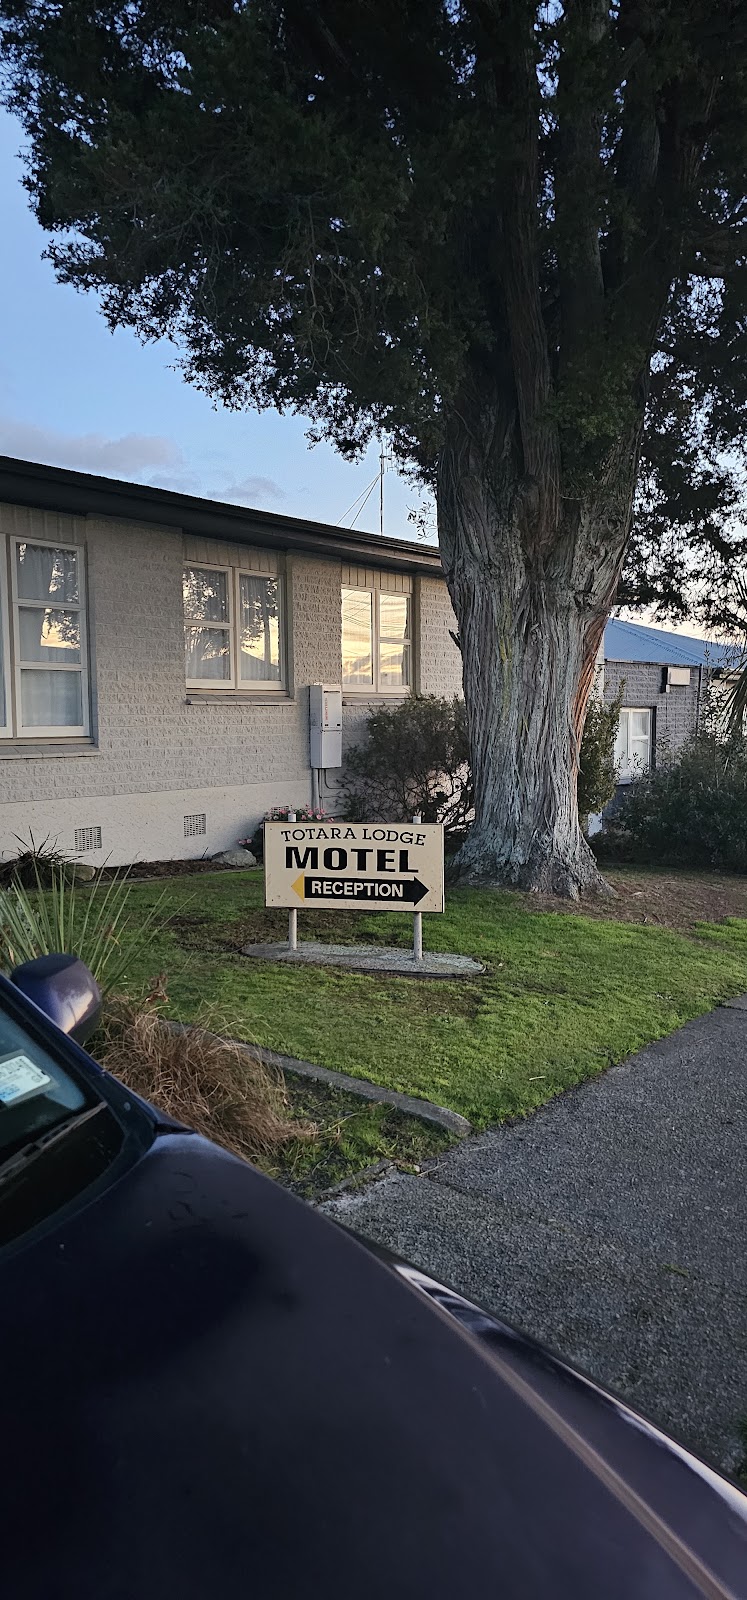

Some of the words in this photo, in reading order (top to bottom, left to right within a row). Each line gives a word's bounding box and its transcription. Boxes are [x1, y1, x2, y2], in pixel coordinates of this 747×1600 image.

[280, 827, 357, 842] TOTARA
[362, 828, 427, 846] LODGE
[285, 846, 419, 873] MOTEL
[311, 880, 404, 898] RECEPTION
